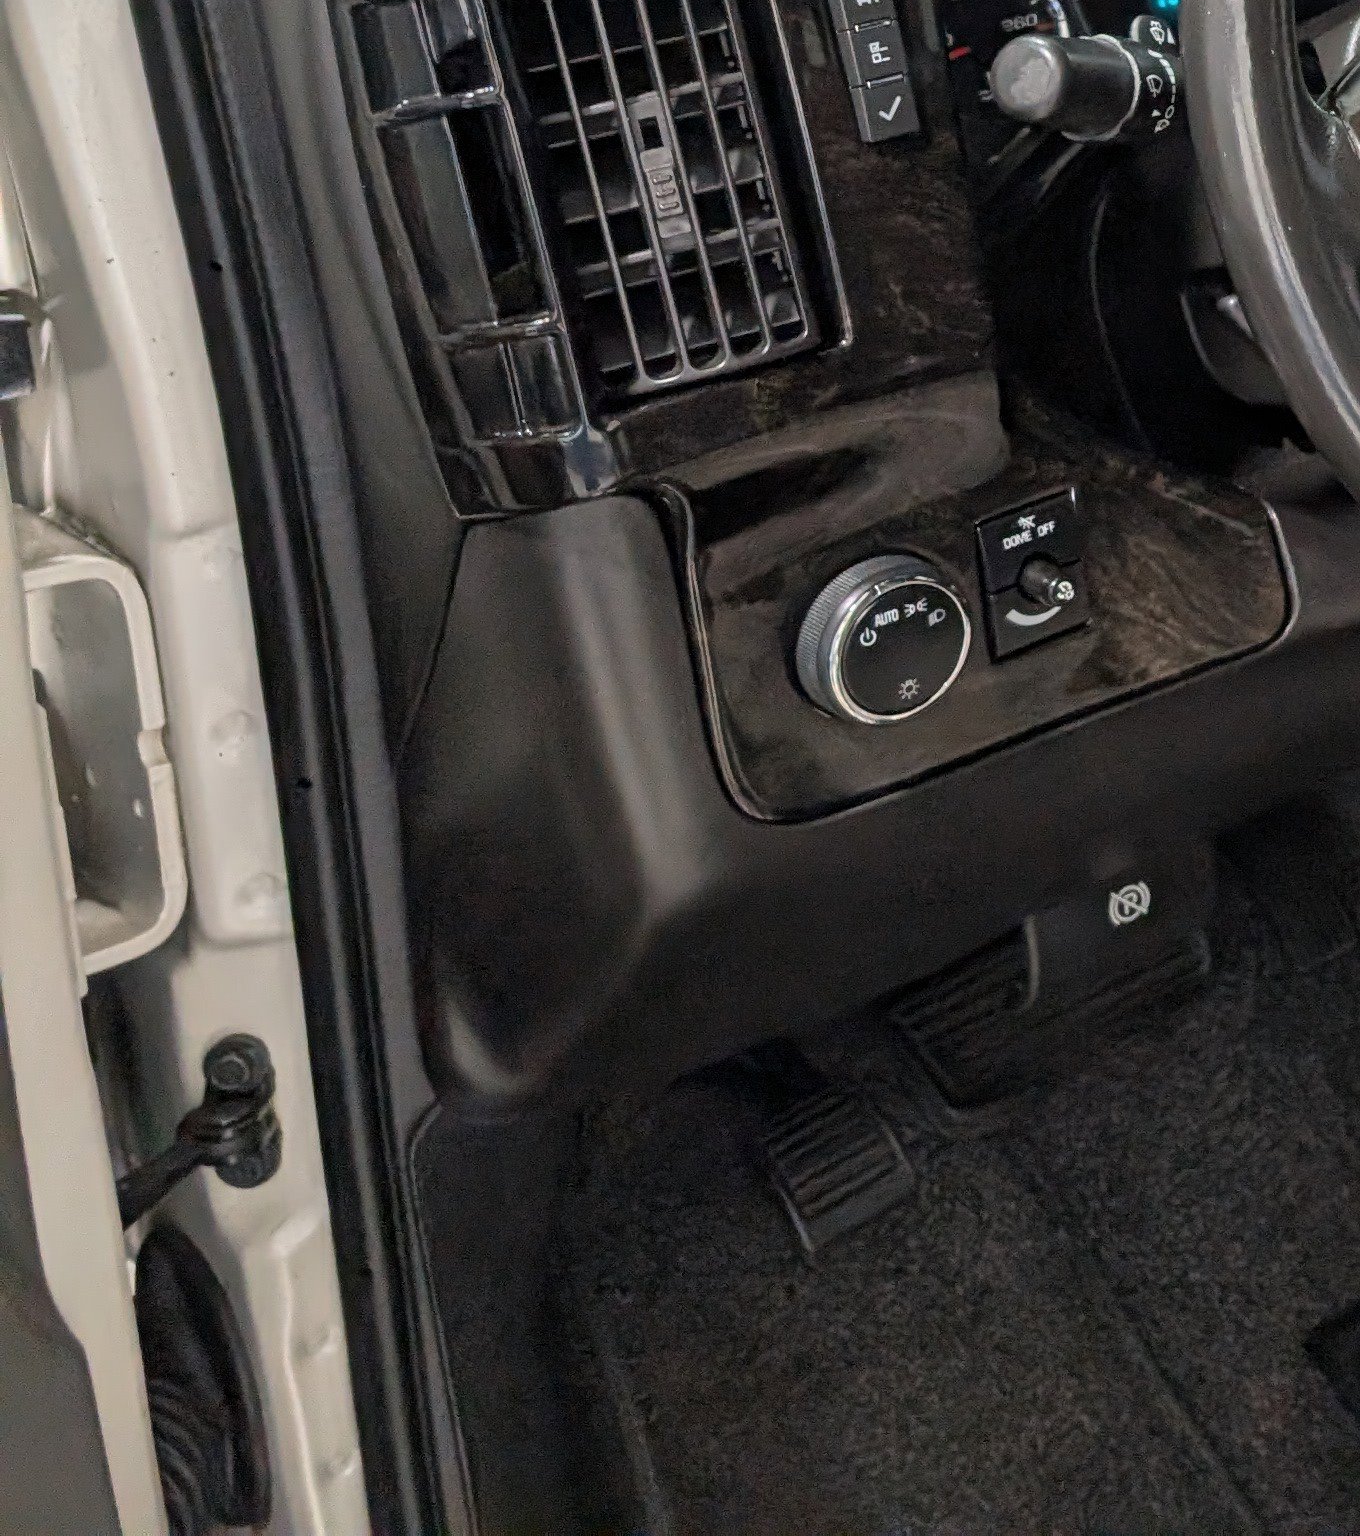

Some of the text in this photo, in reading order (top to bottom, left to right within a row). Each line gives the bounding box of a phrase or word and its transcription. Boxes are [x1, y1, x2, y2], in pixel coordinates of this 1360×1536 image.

[1002, 520, 1056, 550] DOME OFF
[874, 607, 900, 628] AUTO
